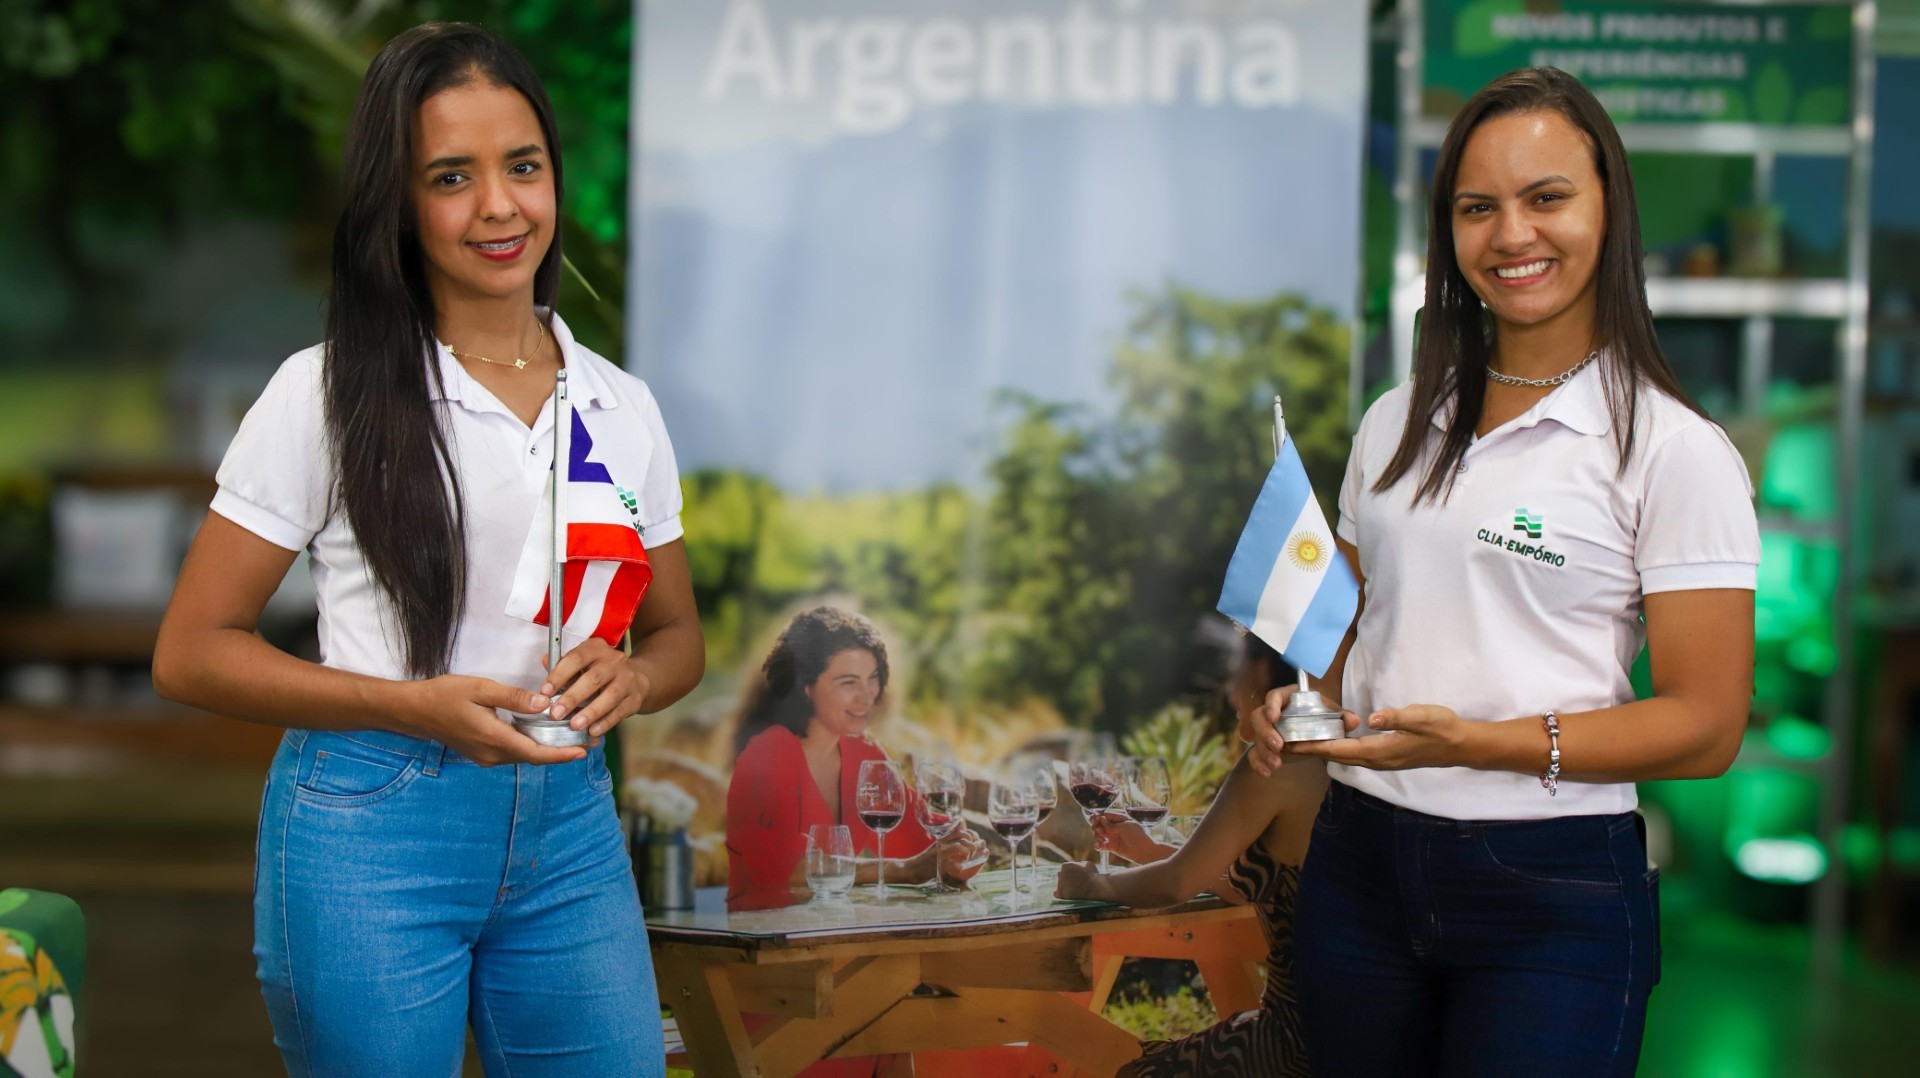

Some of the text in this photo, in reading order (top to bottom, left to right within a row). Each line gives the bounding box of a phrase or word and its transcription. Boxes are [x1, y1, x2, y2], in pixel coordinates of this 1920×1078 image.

[701, 0, 1301, 132] Argentina
[1490, 13, 1787, 43] NOVOS PRODUTOS E
